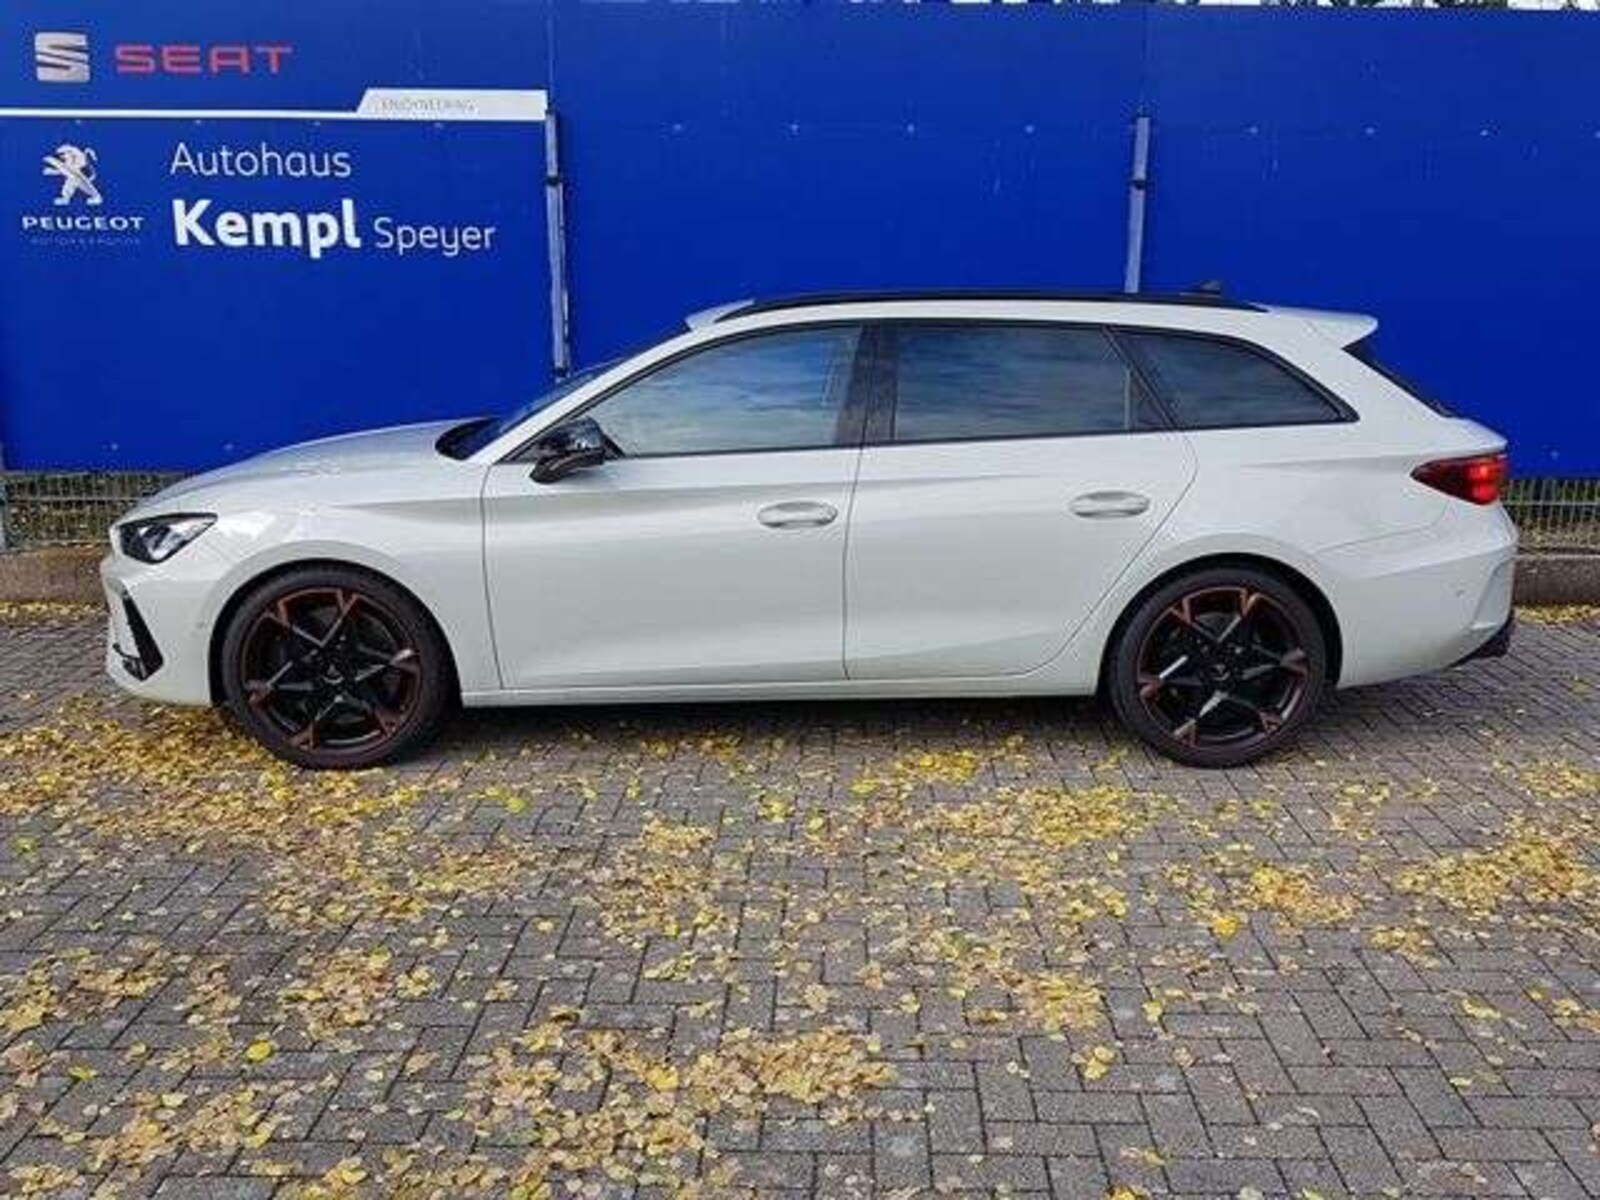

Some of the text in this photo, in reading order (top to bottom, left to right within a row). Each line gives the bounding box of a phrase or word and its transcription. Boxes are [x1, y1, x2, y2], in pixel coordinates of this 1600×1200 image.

[115, 45, 293, 73] SEAT
[170, 143, 352, 178] Autohaus
[22, 216, 144, 230] PEUGEOT
[171, 199, 496, 258] Kempl Speyer
